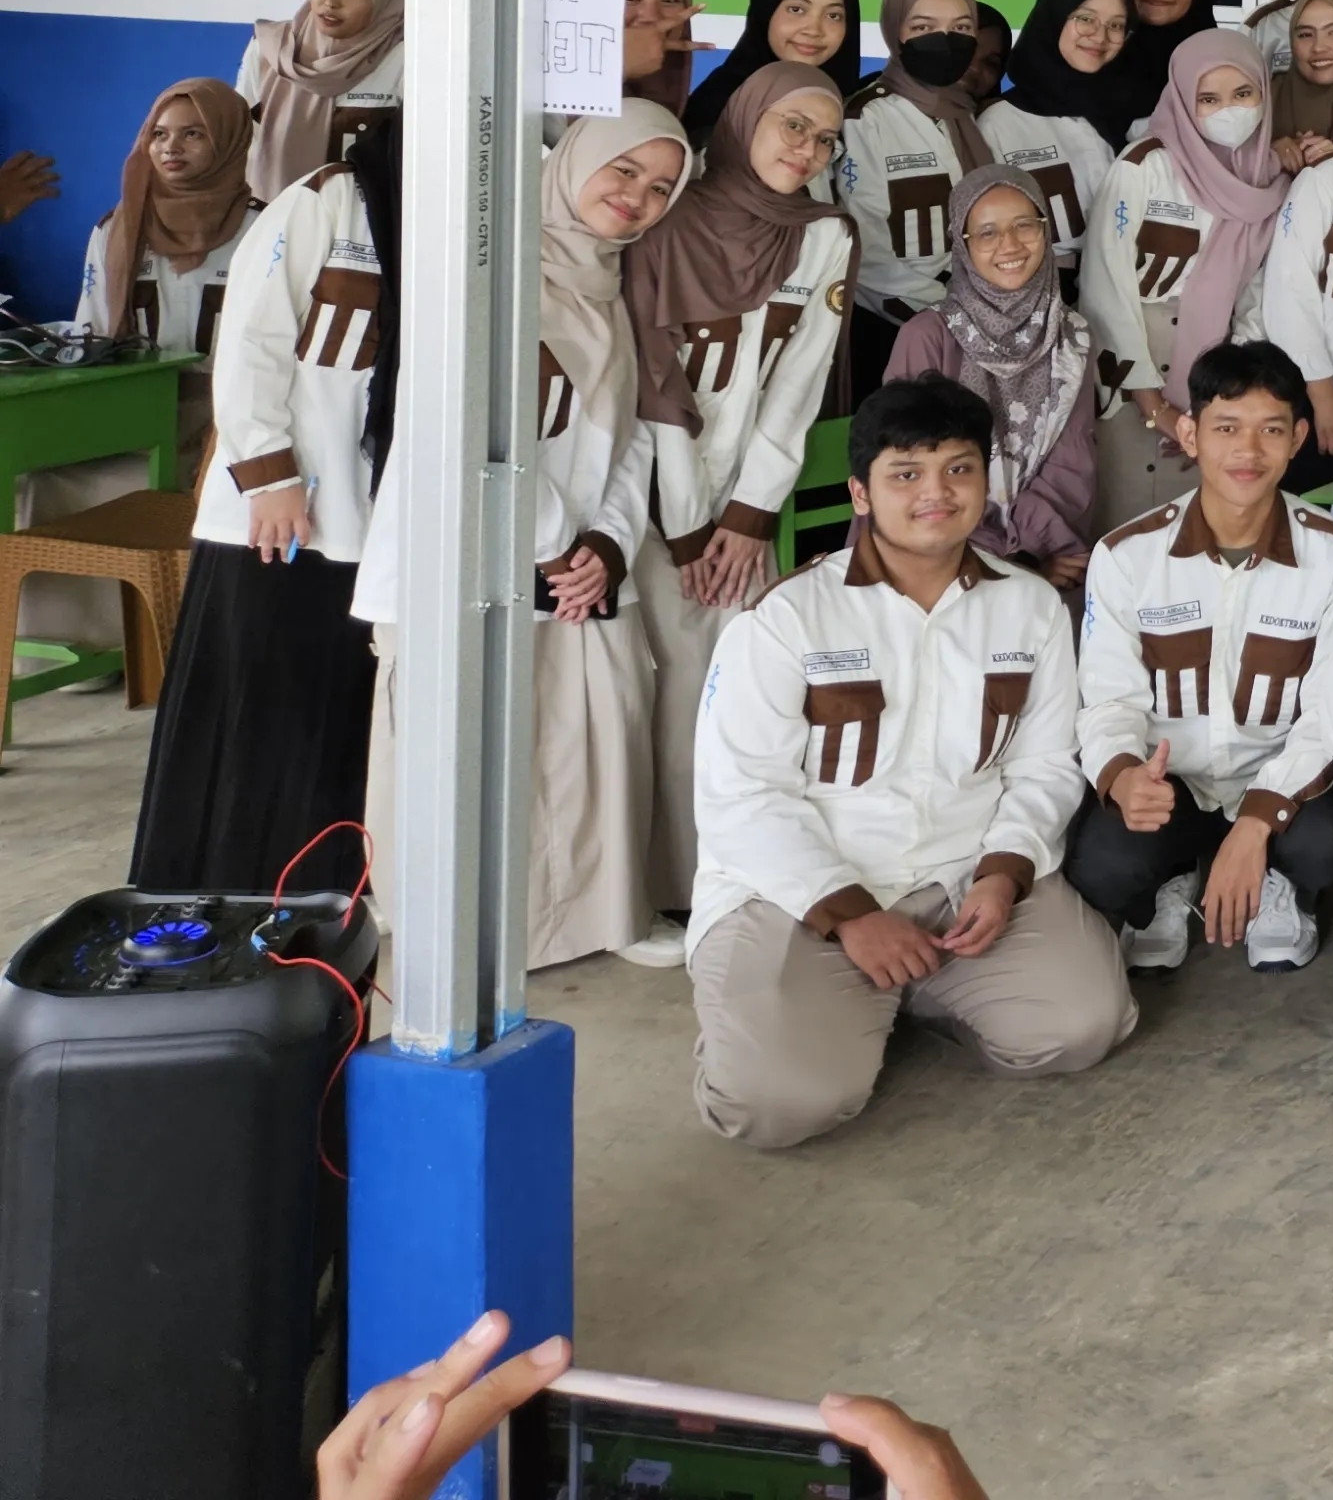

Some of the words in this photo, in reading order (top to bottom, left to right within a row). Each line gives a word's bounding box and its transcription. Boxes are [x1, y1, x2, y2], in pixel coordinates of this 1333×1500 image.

[479, 95, 492, 146] KASO
[478, 150, 489, 187] (KSO)
[478, 190, 489, 212] 150
[478, 223, 488, 267] C75.75
[1259, 614, 1309, 630] KEDOKTERAN
